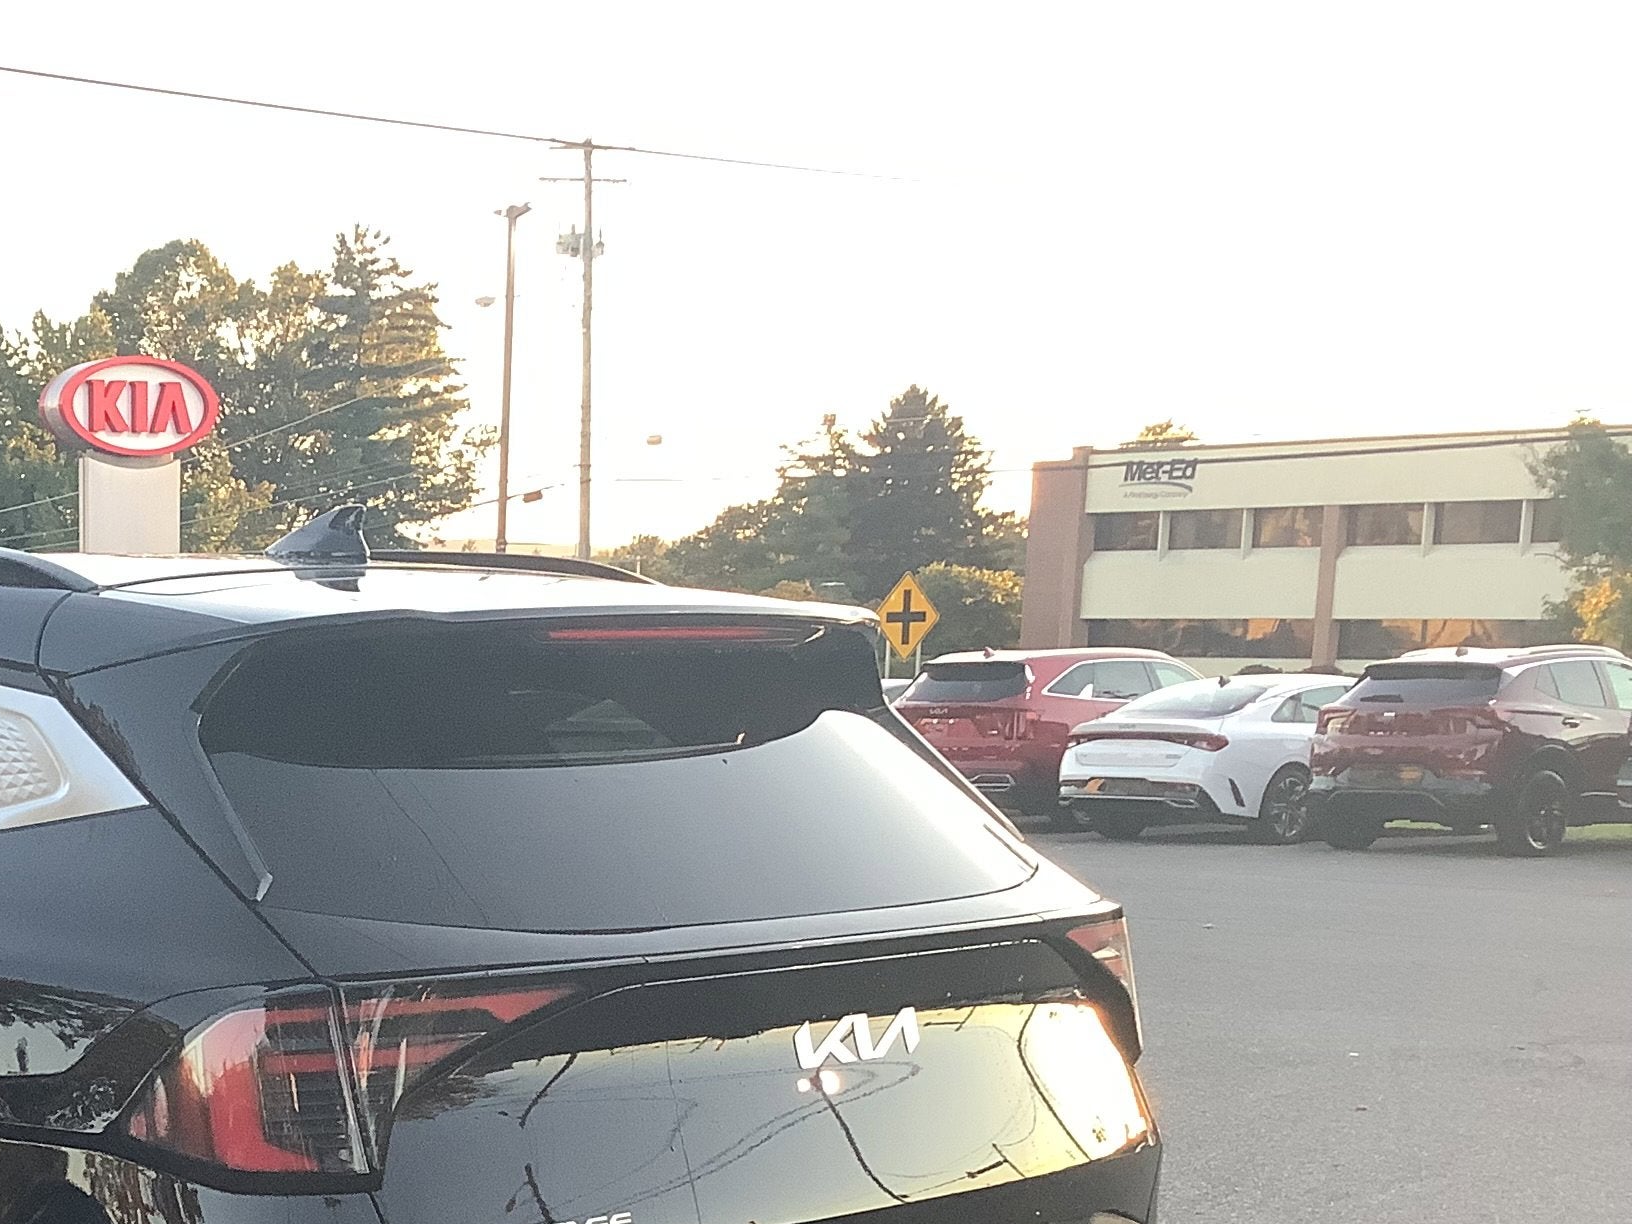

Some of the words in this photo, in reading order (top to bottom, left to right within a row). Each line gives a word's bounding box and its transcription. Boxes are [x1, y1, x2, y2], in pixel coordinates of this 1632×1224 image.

[87, 379, 193, 434] KIA
[1123, 458, 1198, 482] Met-Ed
[793, 1006, 921, 1070] KIA
